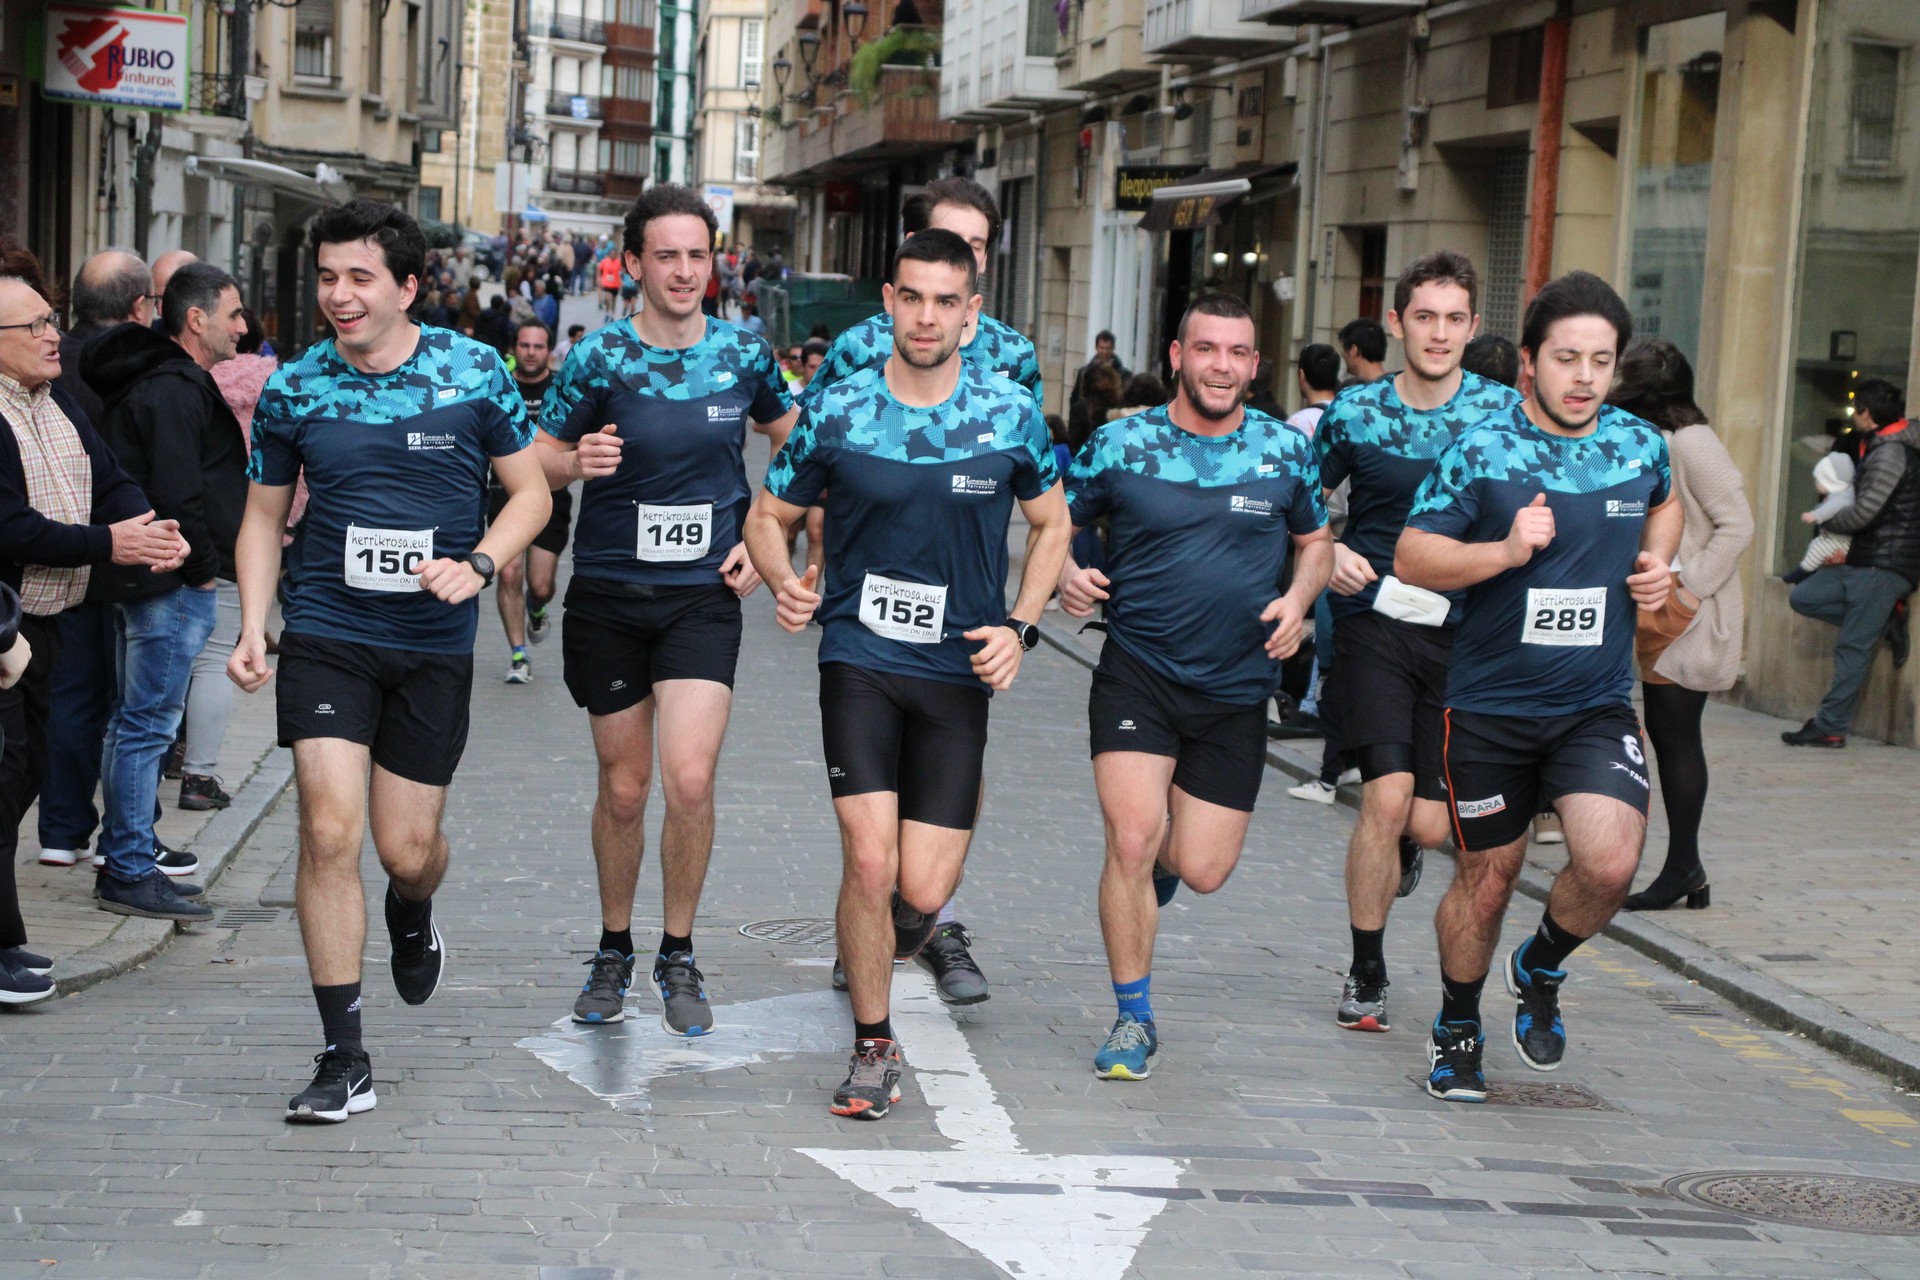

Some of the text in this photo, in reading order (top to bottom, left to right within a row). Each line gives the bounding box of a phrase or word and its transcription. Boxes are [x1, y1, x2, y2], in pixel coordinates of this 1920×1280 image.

[107, 44, 175, 80] RUBIO
[642, 508, 709, 522] herrikrosa.eus
[351, 530, 429, 549] herrikrosa.eus
[647, 523, 703, 546] 149
[356, 548, 424, 576] 150
[868, 578, 942, 605] herrikrosa.eus
[1534, 592, 1603, 607] herrikrosa.eus
[872, 596, 935, 629] 152
[1534, 608, 1598, 632] 289
[1622, 734, 1644, 766] 6
